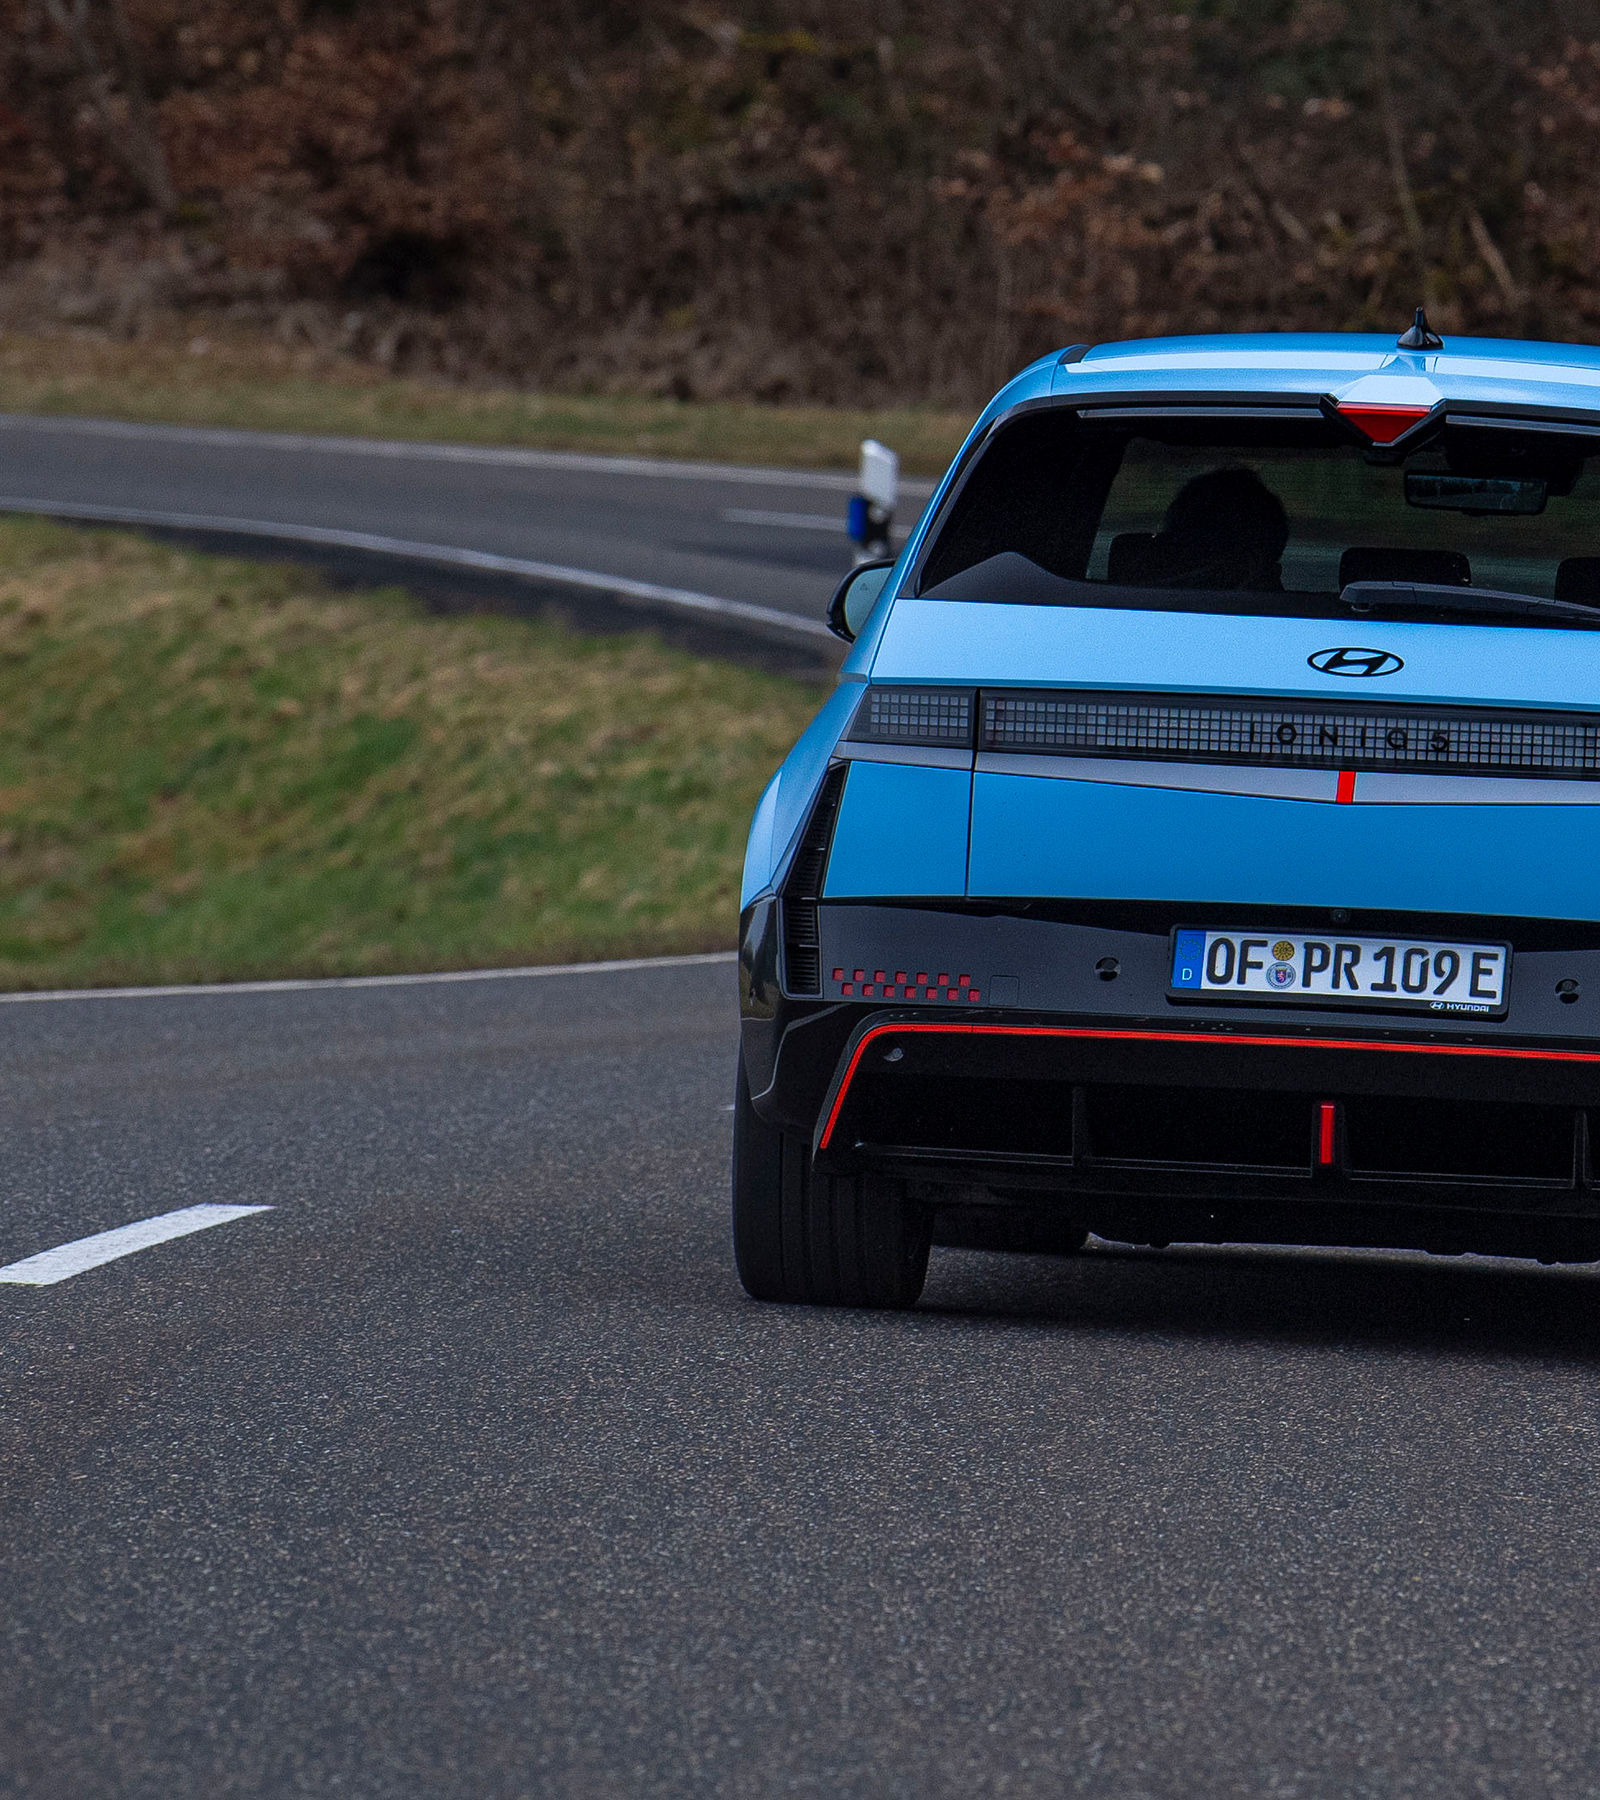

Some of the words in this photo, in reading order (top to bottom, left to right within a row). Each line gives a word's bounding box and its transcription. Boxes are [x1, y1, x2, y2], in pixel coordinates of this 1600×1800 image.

[1250, 721, 1408, 750] IONIQ
[1430, 731, 1451, 751] 5
[1206, 937, 1269, 985] OF
[1301, 942, 1361, 990] PR
[1182, 968, 1193, 981] D
[1446, 1002, 1490, 1012] HYUNDAI
